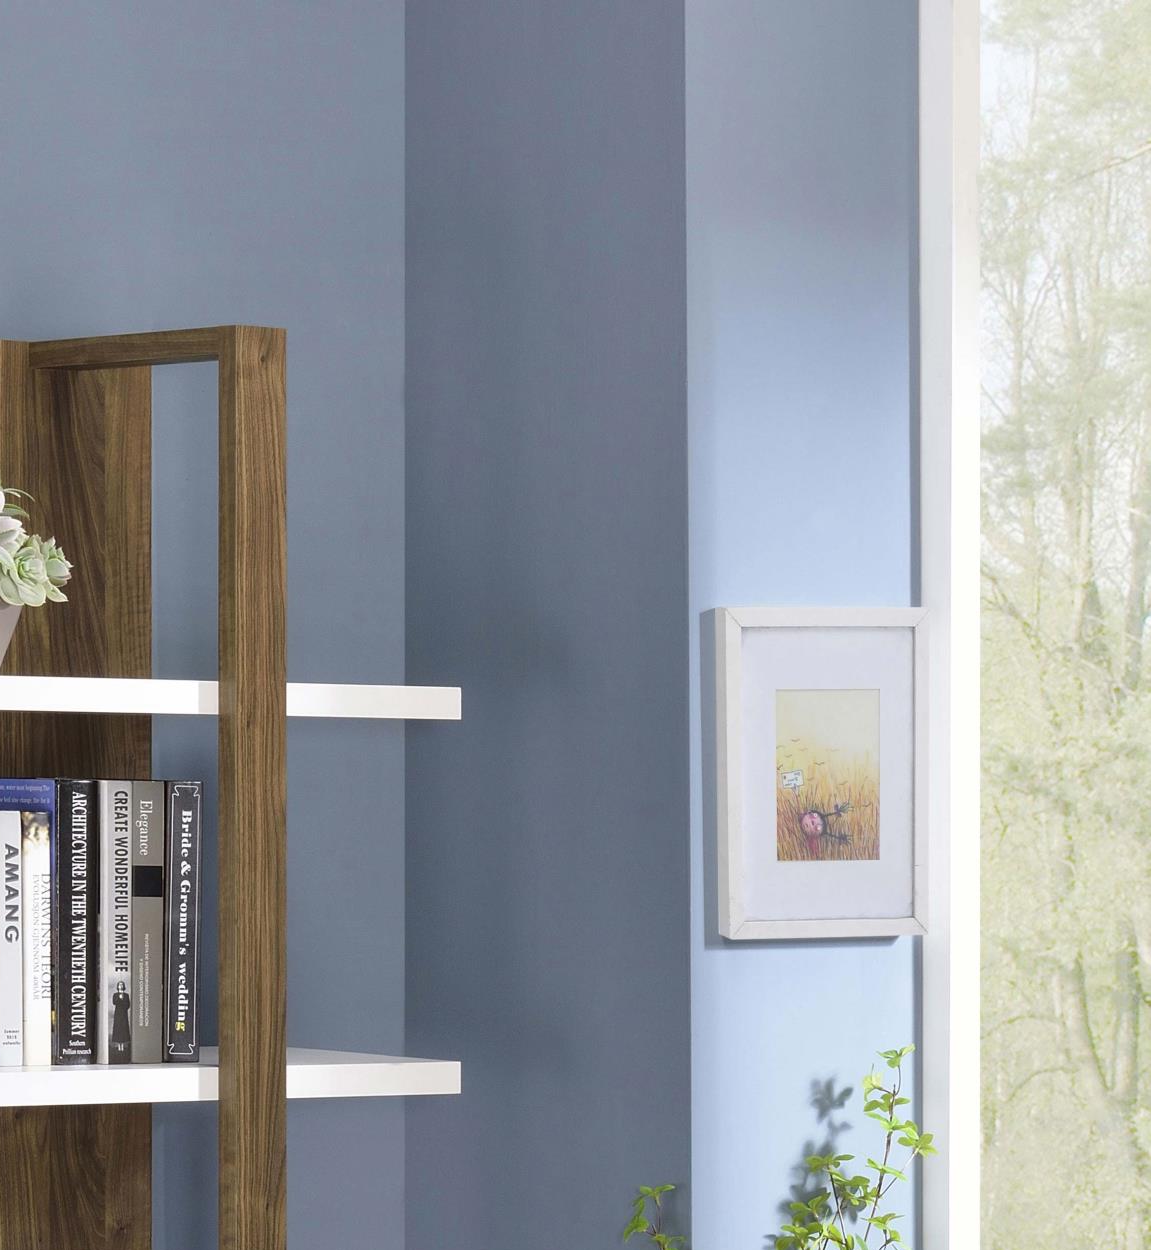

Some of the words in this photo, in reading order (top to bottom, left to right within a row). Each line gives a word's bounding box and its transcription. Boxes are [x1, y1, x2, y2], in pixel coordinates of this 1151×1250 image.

[114, 790, 129, 833] CREATE
[135, 799, 153, 856] Elegance
[180, 809, 193, 857] Bride
[4, 843, 20, 943] AMANG
[71, 880, 87, 892] IN
[114, 837, 129, 910] WONDERFUL
[180, 860, 192, 877] &
[41, 873, 51, 947] DARWINS
[71, 894, 87, 916] THE
[178, 879, 191, 955] Gromm's
[71, 919, 87, 983] TWENTIETH
[114, 914, 129, 973] HOMELIFE
[71, 985, 87, 1037] CENTURY
[175, 963, 189, 1032] wedding
